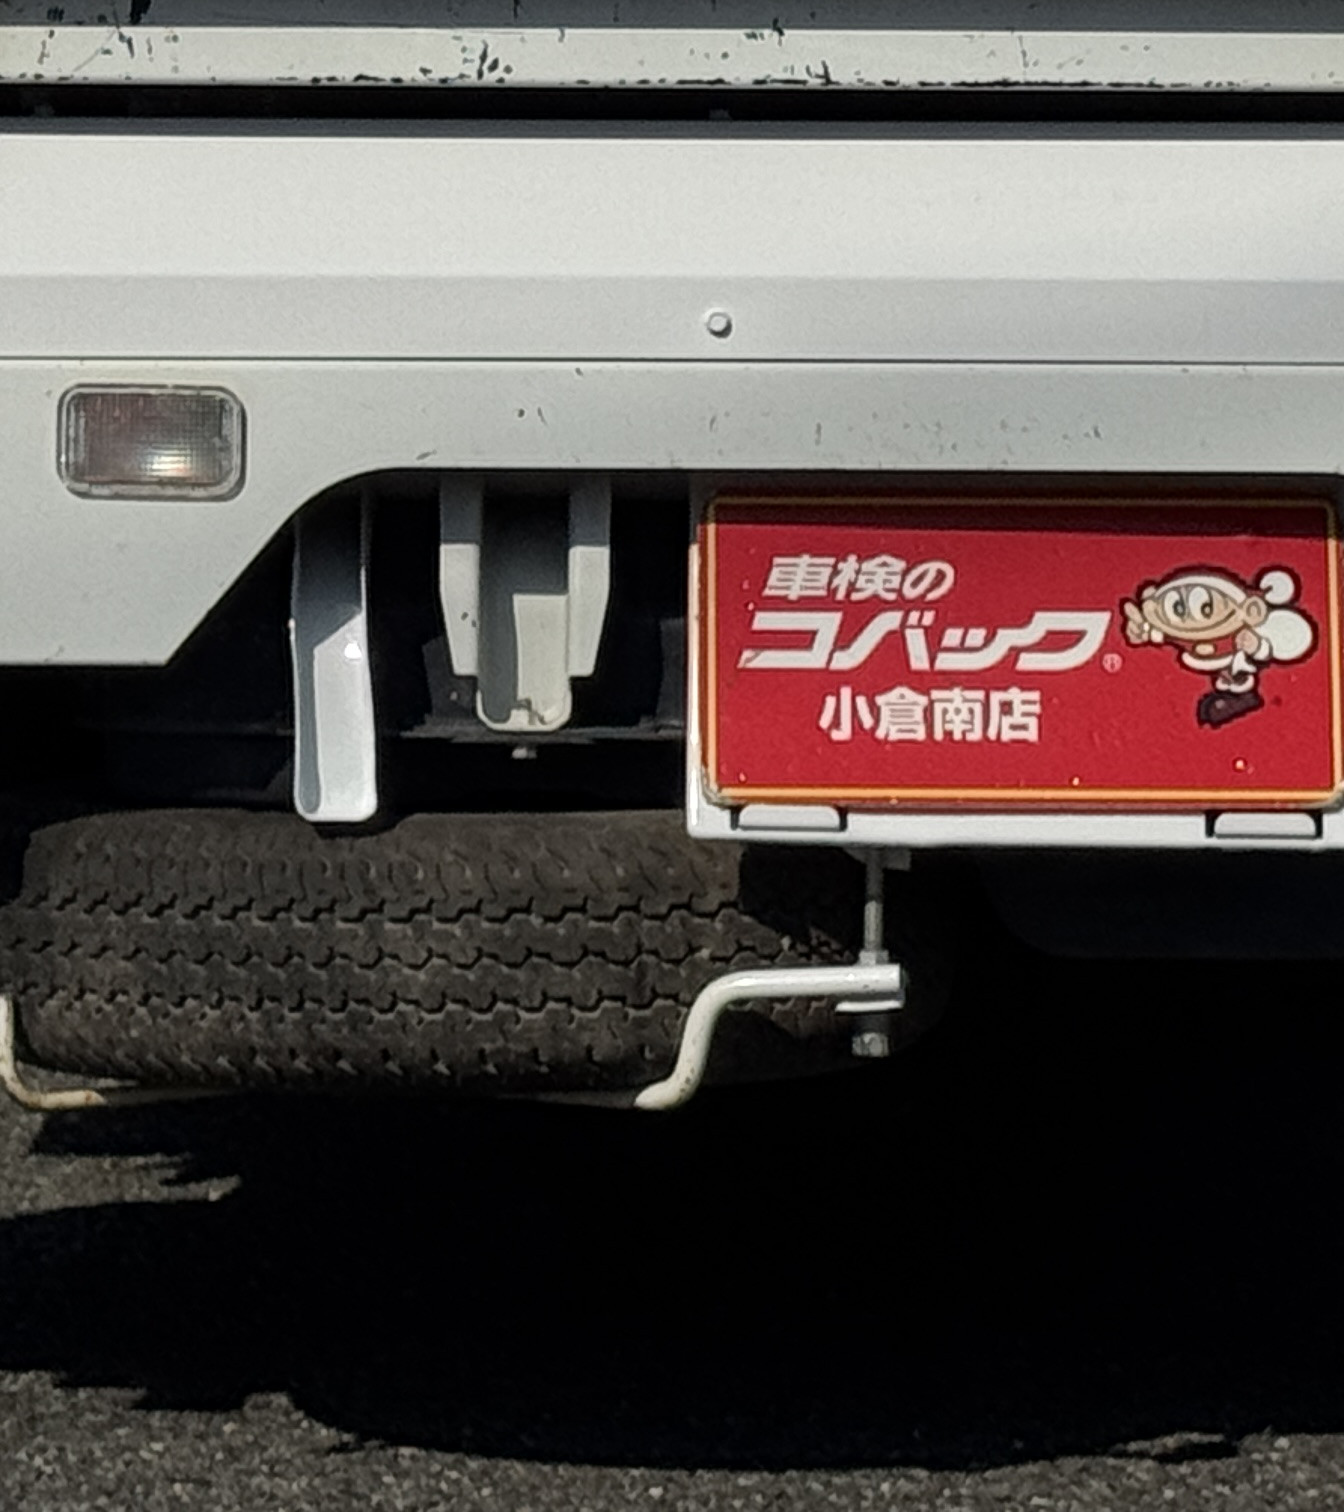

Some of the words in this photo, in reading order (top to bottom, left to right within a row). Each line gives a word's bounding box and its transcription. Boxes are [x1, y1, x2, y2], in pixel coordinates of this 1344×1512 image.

[761, 553, 956, 601] 車検の
[736, 609, 1113, 672] コバック
[818, 685, 1043, 743] 小倉南店
